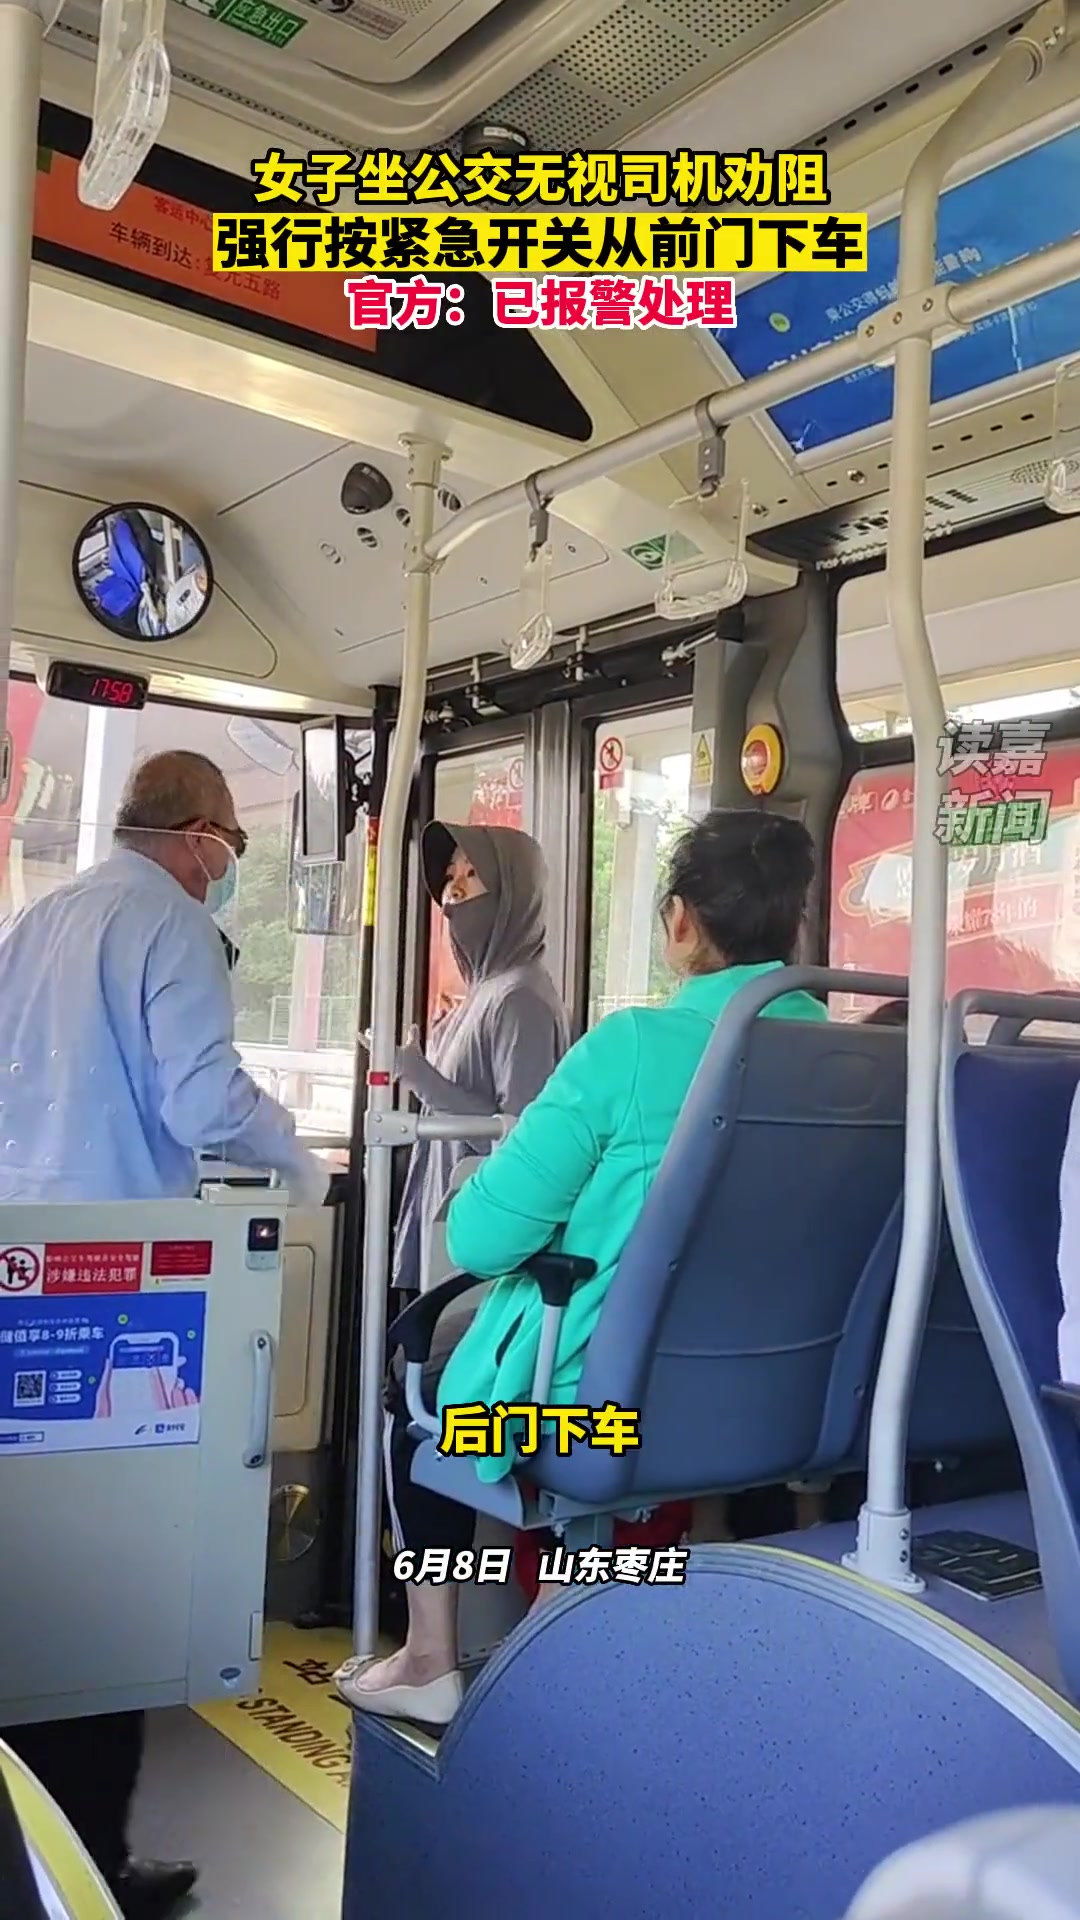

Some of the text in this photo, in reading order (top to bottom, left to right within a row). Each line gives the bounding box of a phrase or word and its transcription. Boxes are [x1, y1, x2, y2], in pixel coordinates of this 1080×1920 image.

[230, 0, 299, 37] 应急出口
[46, 1266, 138, 1284] 涉嫌违法犯罪
[236, 1698, 351, 1769] STANDING
